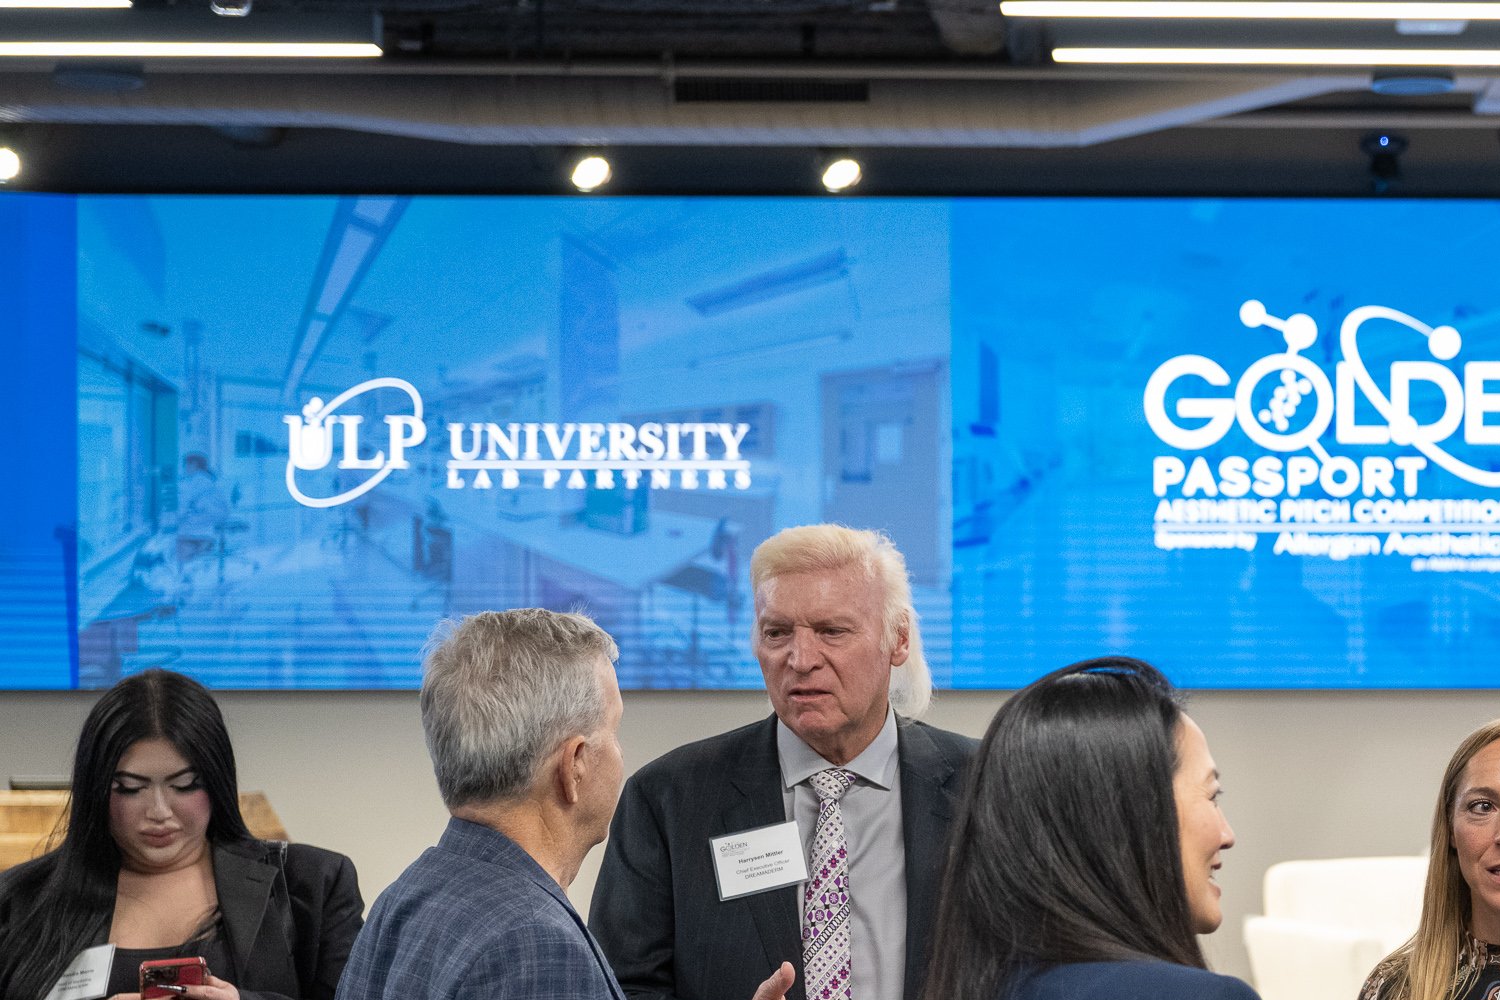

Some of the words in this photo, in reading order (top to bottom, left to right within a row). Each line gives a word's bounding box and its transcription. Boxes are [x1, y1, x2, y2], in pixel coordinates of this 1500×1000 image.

[282, 397, 427, 471] ULP
[446, 422, 750, 461] UNIVERSITY
[446, 469, 520, 490] LAB
[543, 469, 752, 490] PARTNERS
[1152, 456, 1428, 498] PASSPORT
[1154, 498, 1278, 524] AESTHETIC
[1280, 498, 1350, 524] PITCH
